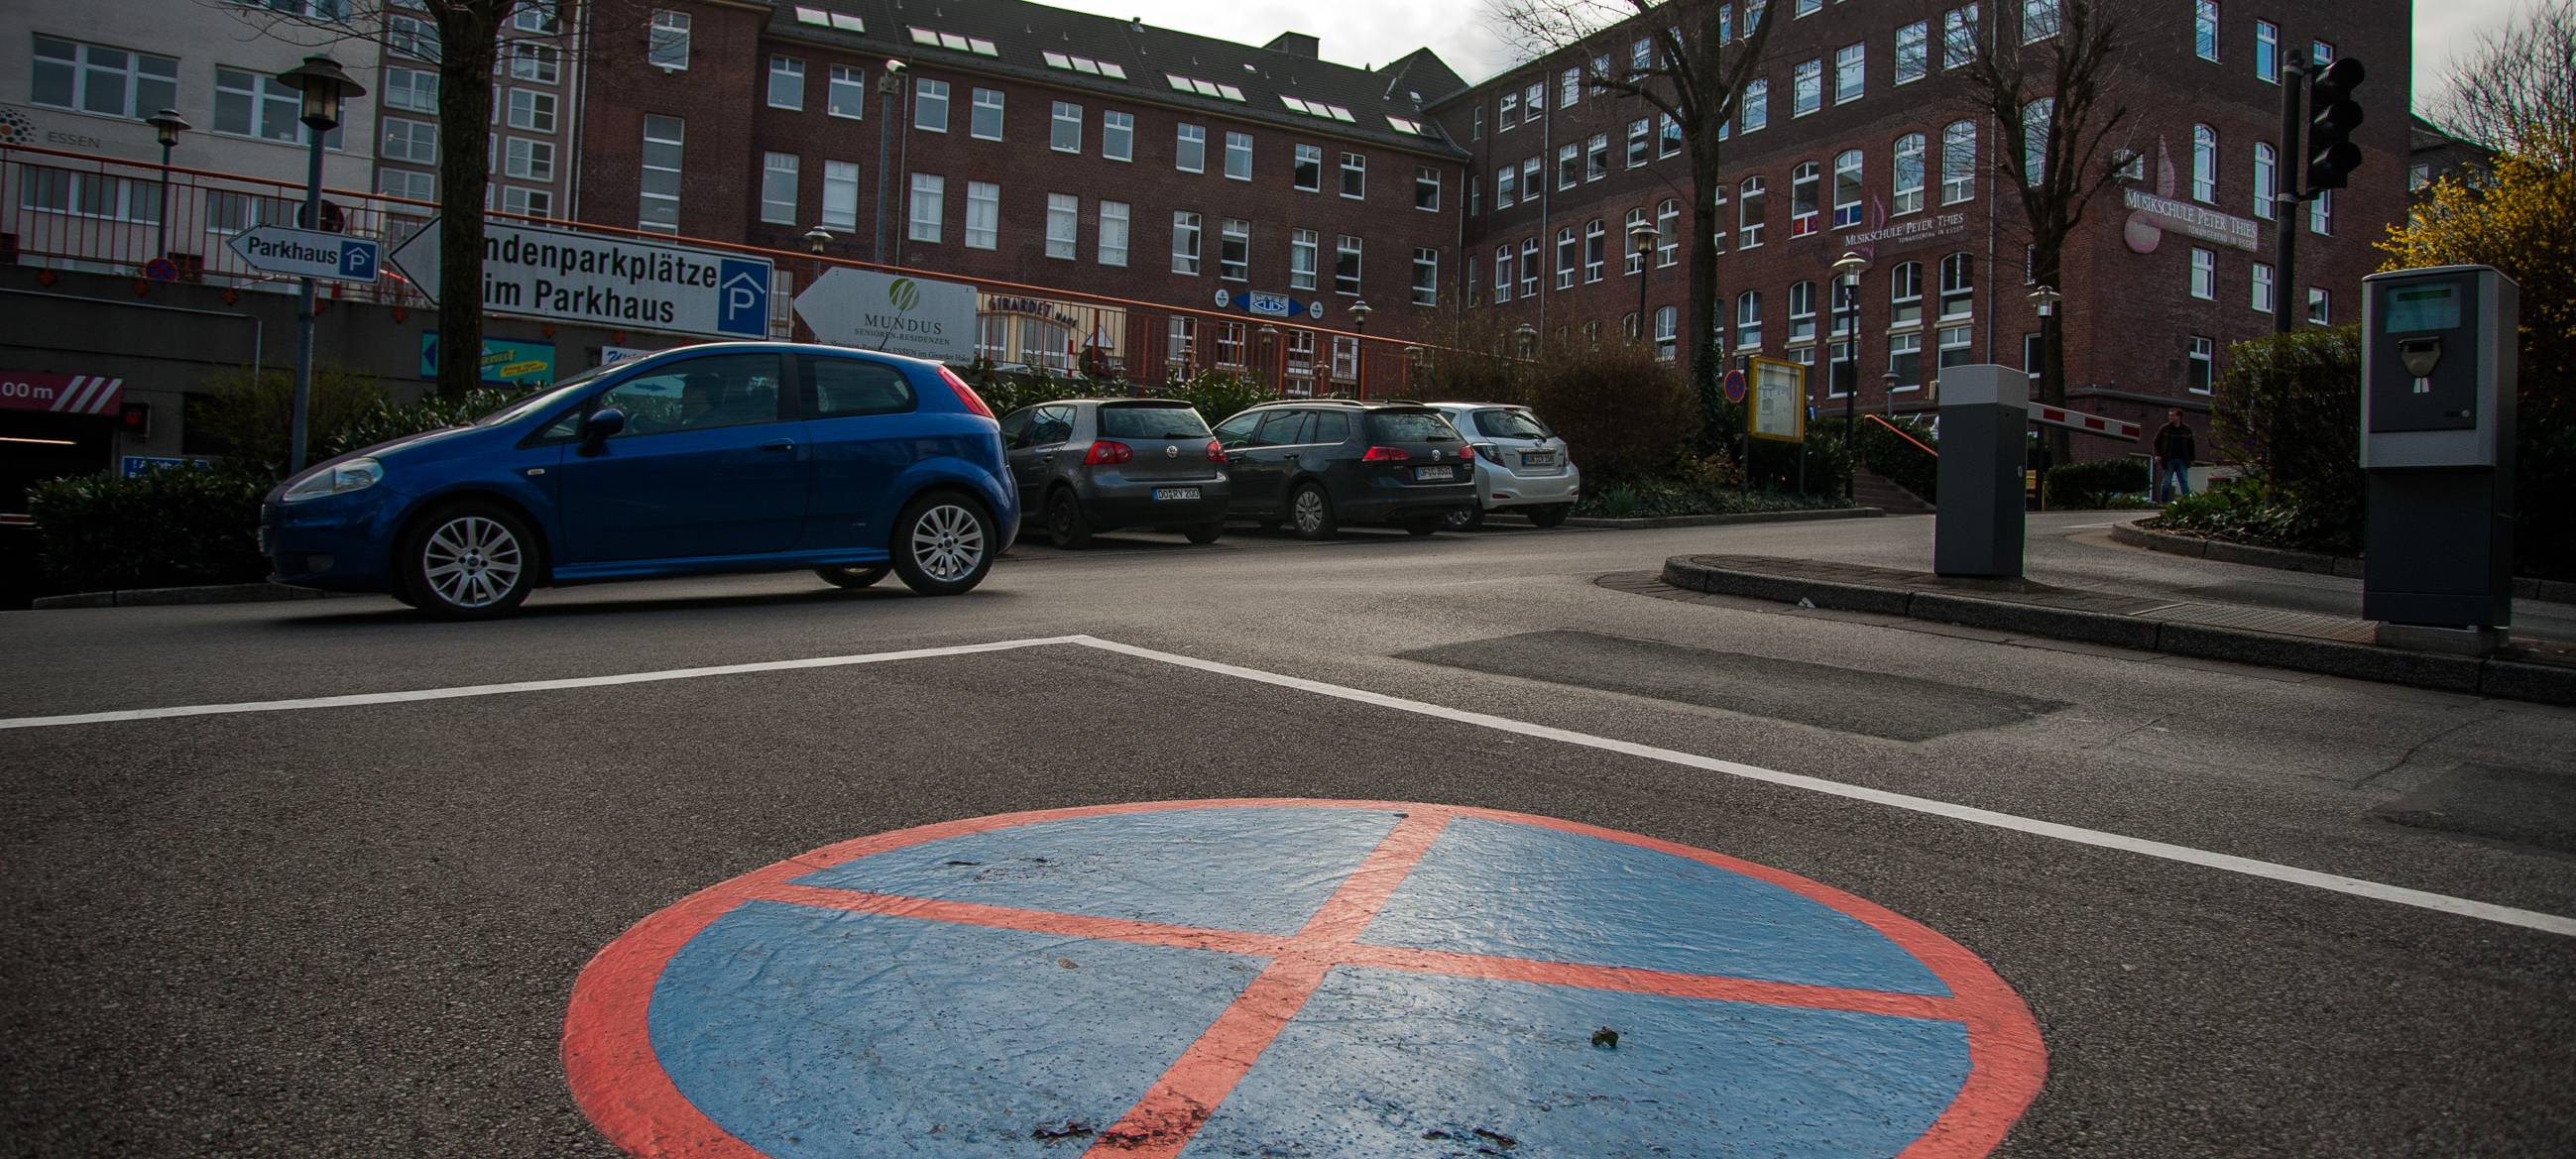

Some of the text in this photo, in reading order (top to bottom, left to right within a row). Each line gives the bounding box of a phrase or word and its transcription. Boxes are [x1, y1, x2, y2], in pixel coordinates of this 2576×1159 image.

[48, 131, 101, 149] ESSEN
[2126, 191, 2256, 238] MUSIKSCHULE PETER THIES
[1844, 213, 1963, 246] MUSIKSCHULE PETER THIES
[248, 236, 337, 265] Parkhaus
[484, 234, 718, 288] ndenparkplätze
[349, 255, 365, 271] P
[485, 273, 675, 323] im Parkhaus
[729, 288, 756, 319] P
[989, 297, 1052, 316] GIRARDET
[1253, 300, 1286, 311] CULT
[864, 313, 942, 335] MUNDUS
[854, 328, 950, 344] SENIOREN-RESIDENZEN
[1, 382, 54, 400] 00 m
